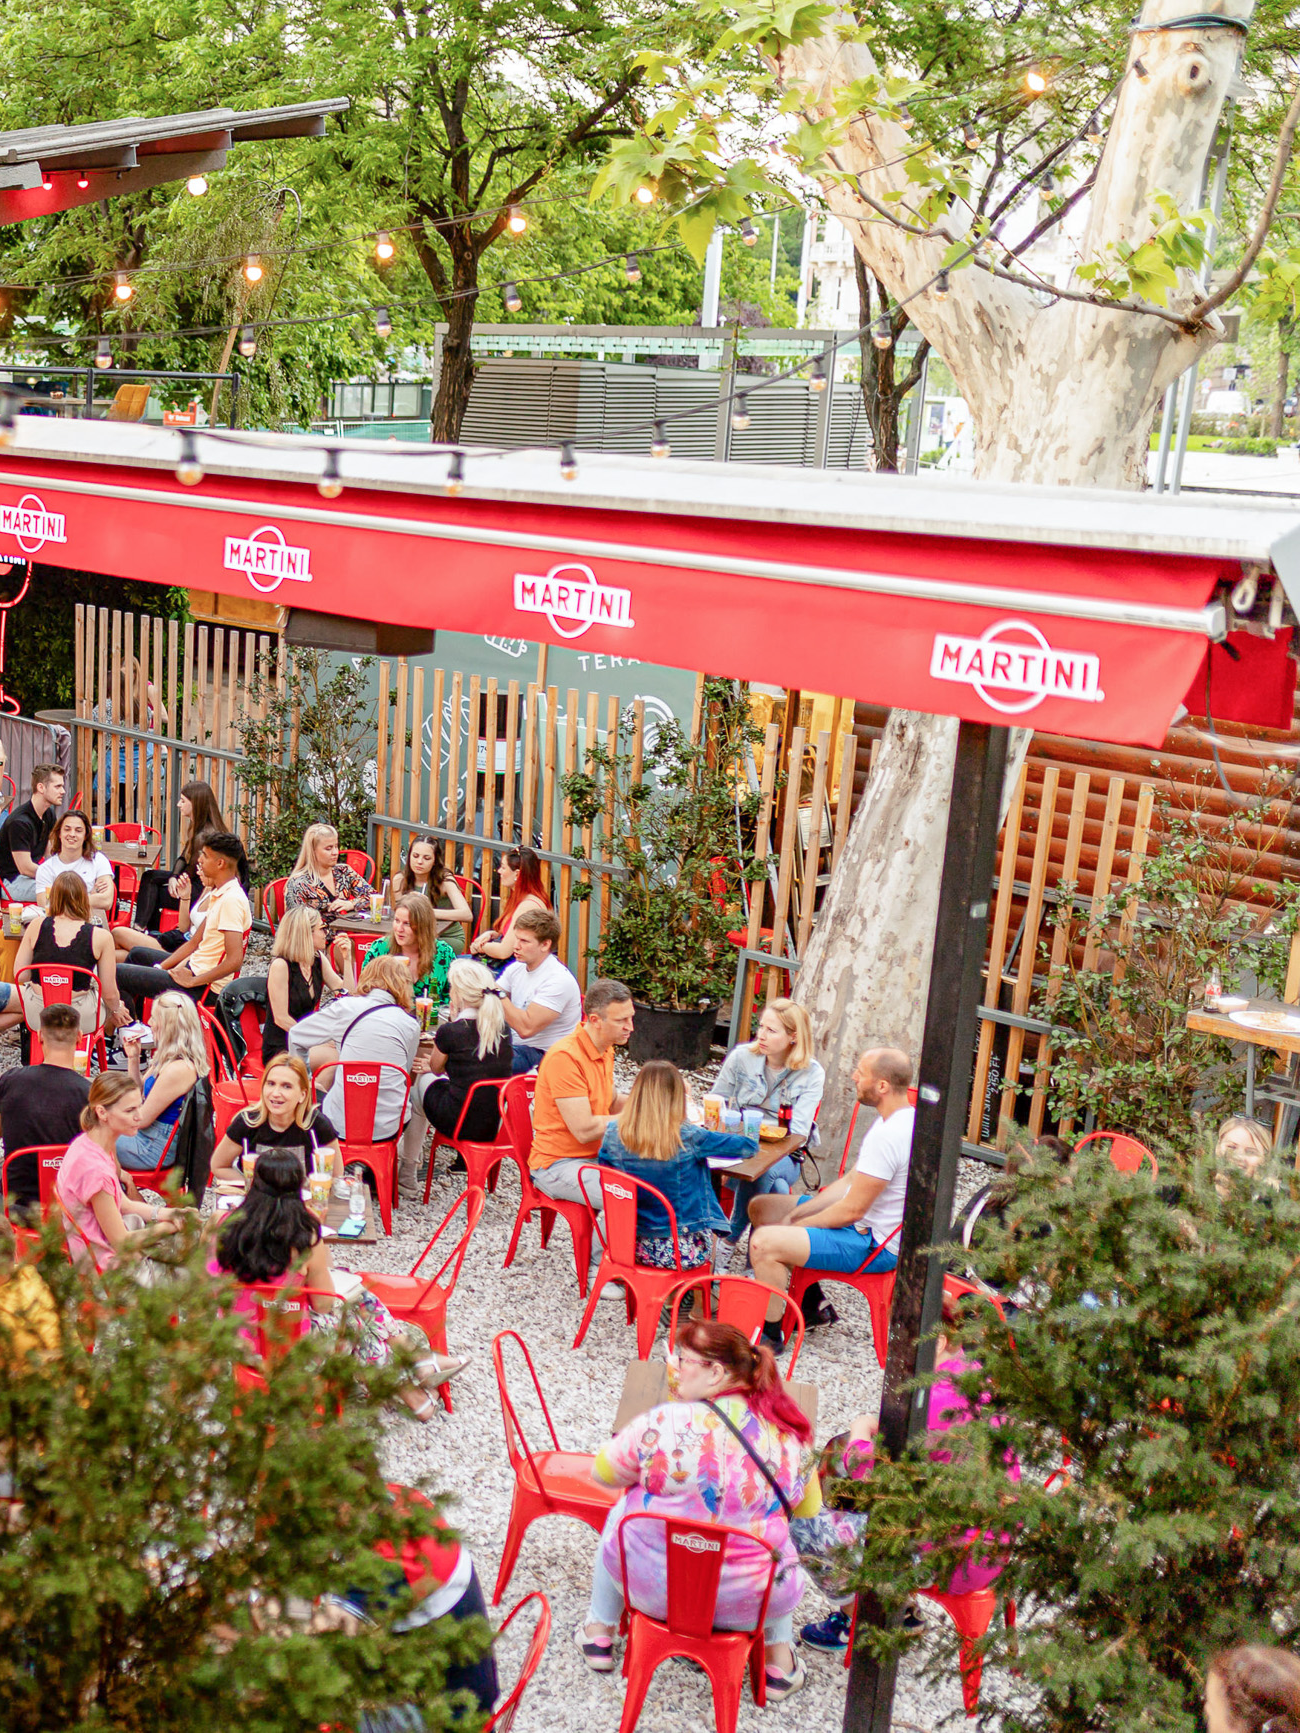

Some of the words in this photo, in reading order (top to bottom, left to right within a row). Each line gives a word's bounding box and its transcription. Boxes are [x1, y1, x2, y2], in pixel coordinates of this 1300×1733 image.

[3, 509, 62, 539] MARTINI
[229, 542, 306, 579] MARTINI
[520, 581, 625, 622] MARTINI
[940, 643, 1089, 691] MARTINI
[605, 1184, 632, 1198] MARTINI
[673, 1535, 719, 1550] MARTINI
